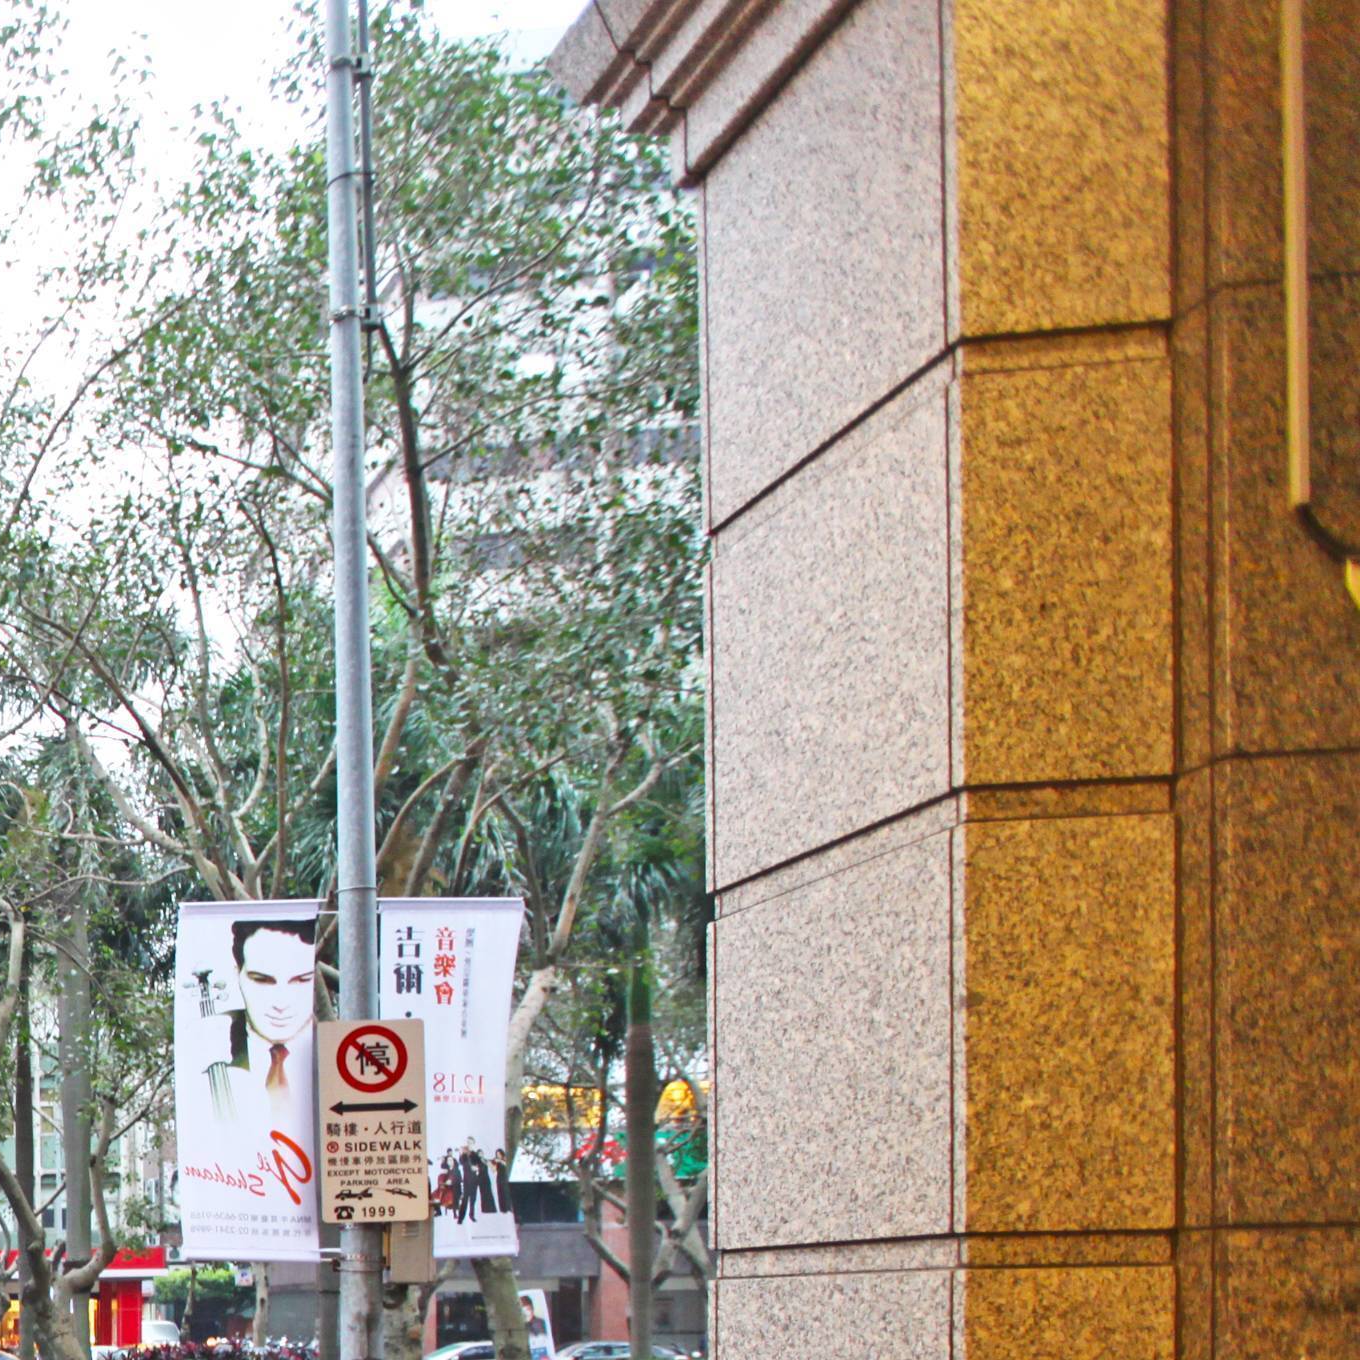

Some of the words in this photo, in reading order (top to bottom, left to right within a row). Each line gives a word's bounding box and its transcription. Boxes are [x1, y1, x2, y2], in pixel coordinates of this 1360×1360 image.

[344, 1140, 422, 1153] SIDEWALK
[327, 1168, 361, 1178] EXCEPT
[364, 1167, 423, 1177] MOTORCYCLE
[340, 1179, 379, 1187] PARKING
[386, 1178, 410, 1186] AREA
[361, 1205, 396, 1218] 1999
